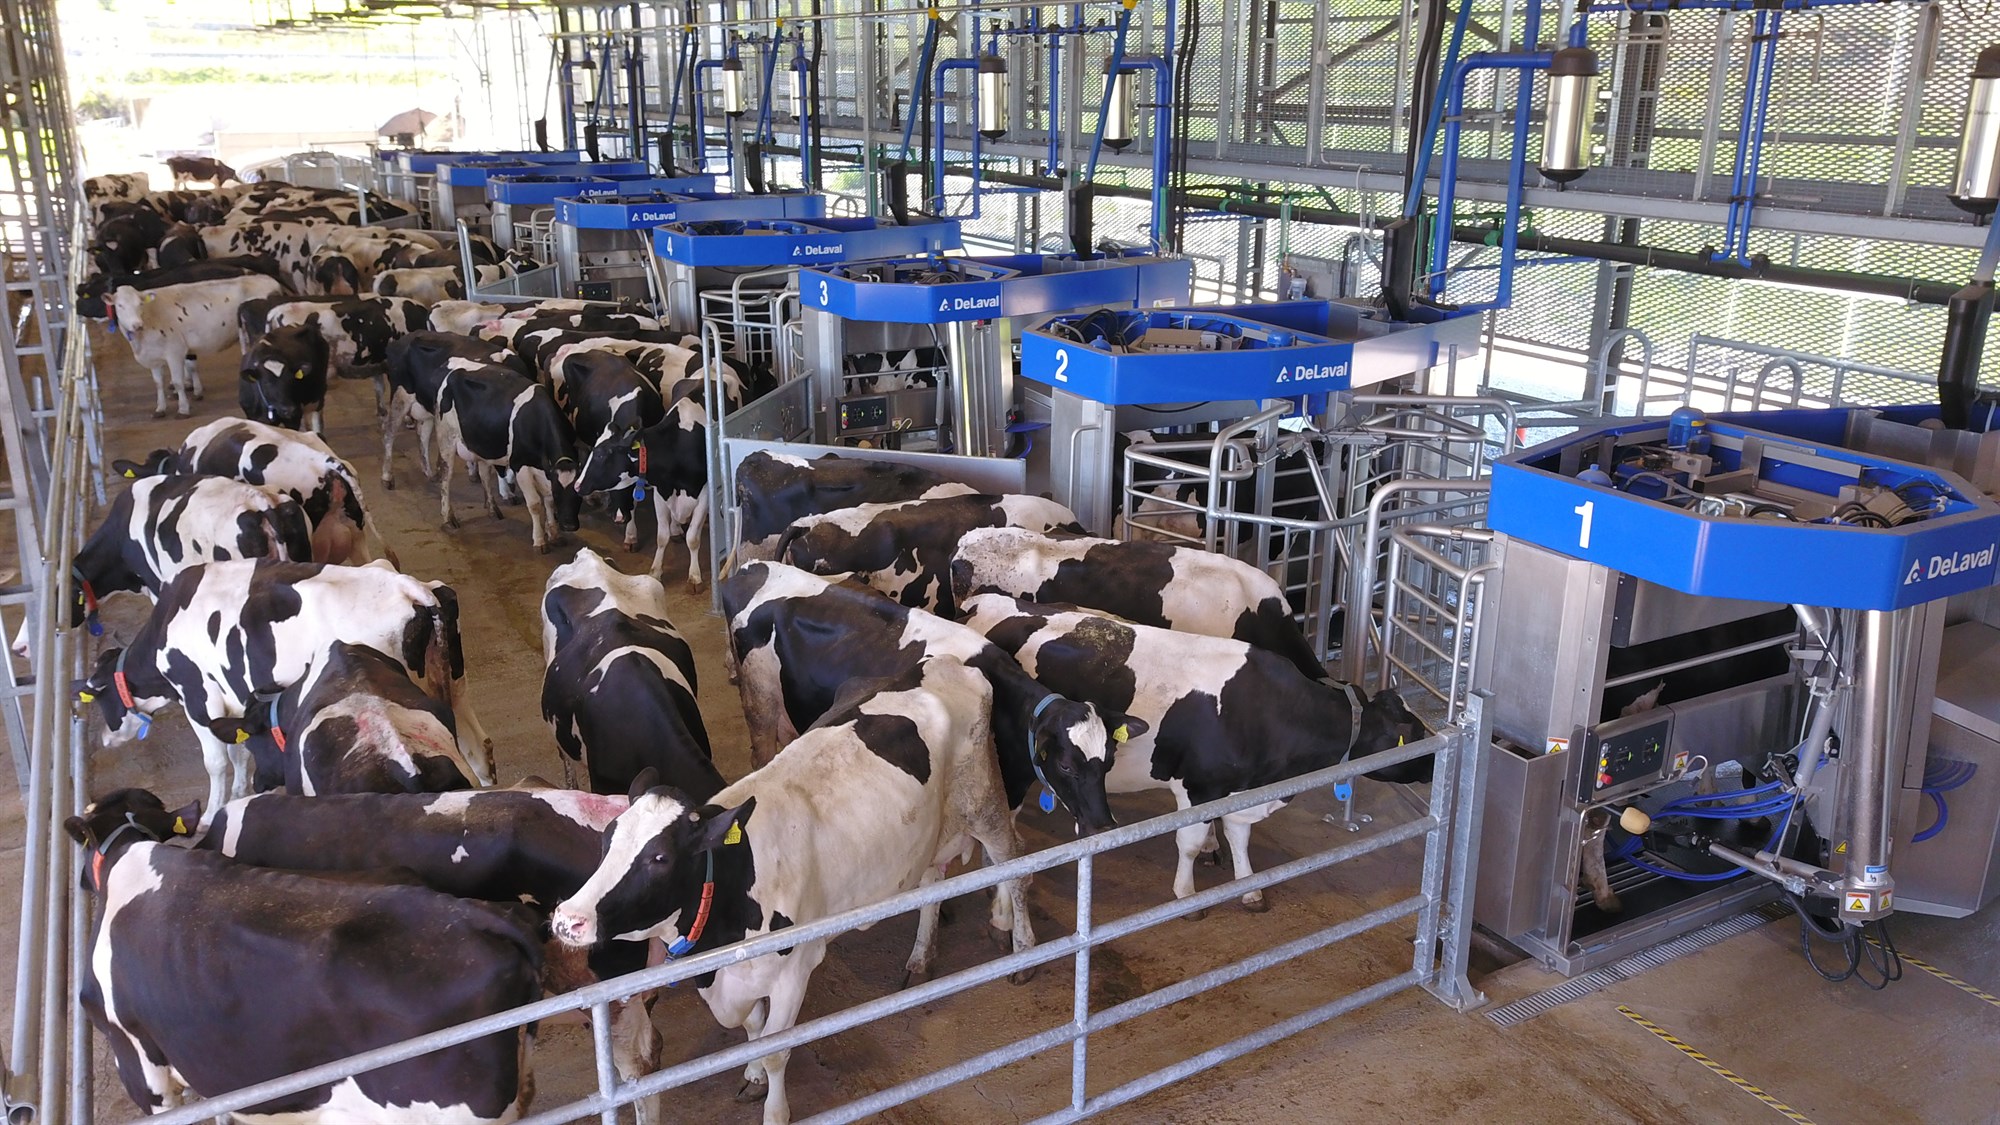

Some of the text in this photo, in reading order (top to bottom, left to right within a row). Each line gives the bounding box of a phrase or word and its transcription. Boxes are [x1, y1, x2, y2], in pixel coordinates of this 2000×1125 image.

[563, 204, 568, 222] 5
[642, 211, 676, 221] DeLaval
[667, 236, 673, 256] 4
[805, 243, 843, 256] DeLaval
[819, 280, 828, 306] 3
[954, 295, 1000, 310] DeLaval
[1055, 348, 1068, 383] 2
[1295, 361, 1348, 381] DeLaval
[1574, 500, 1594, 549] 1
[1927, 543, 1995, 580] DeLaval
